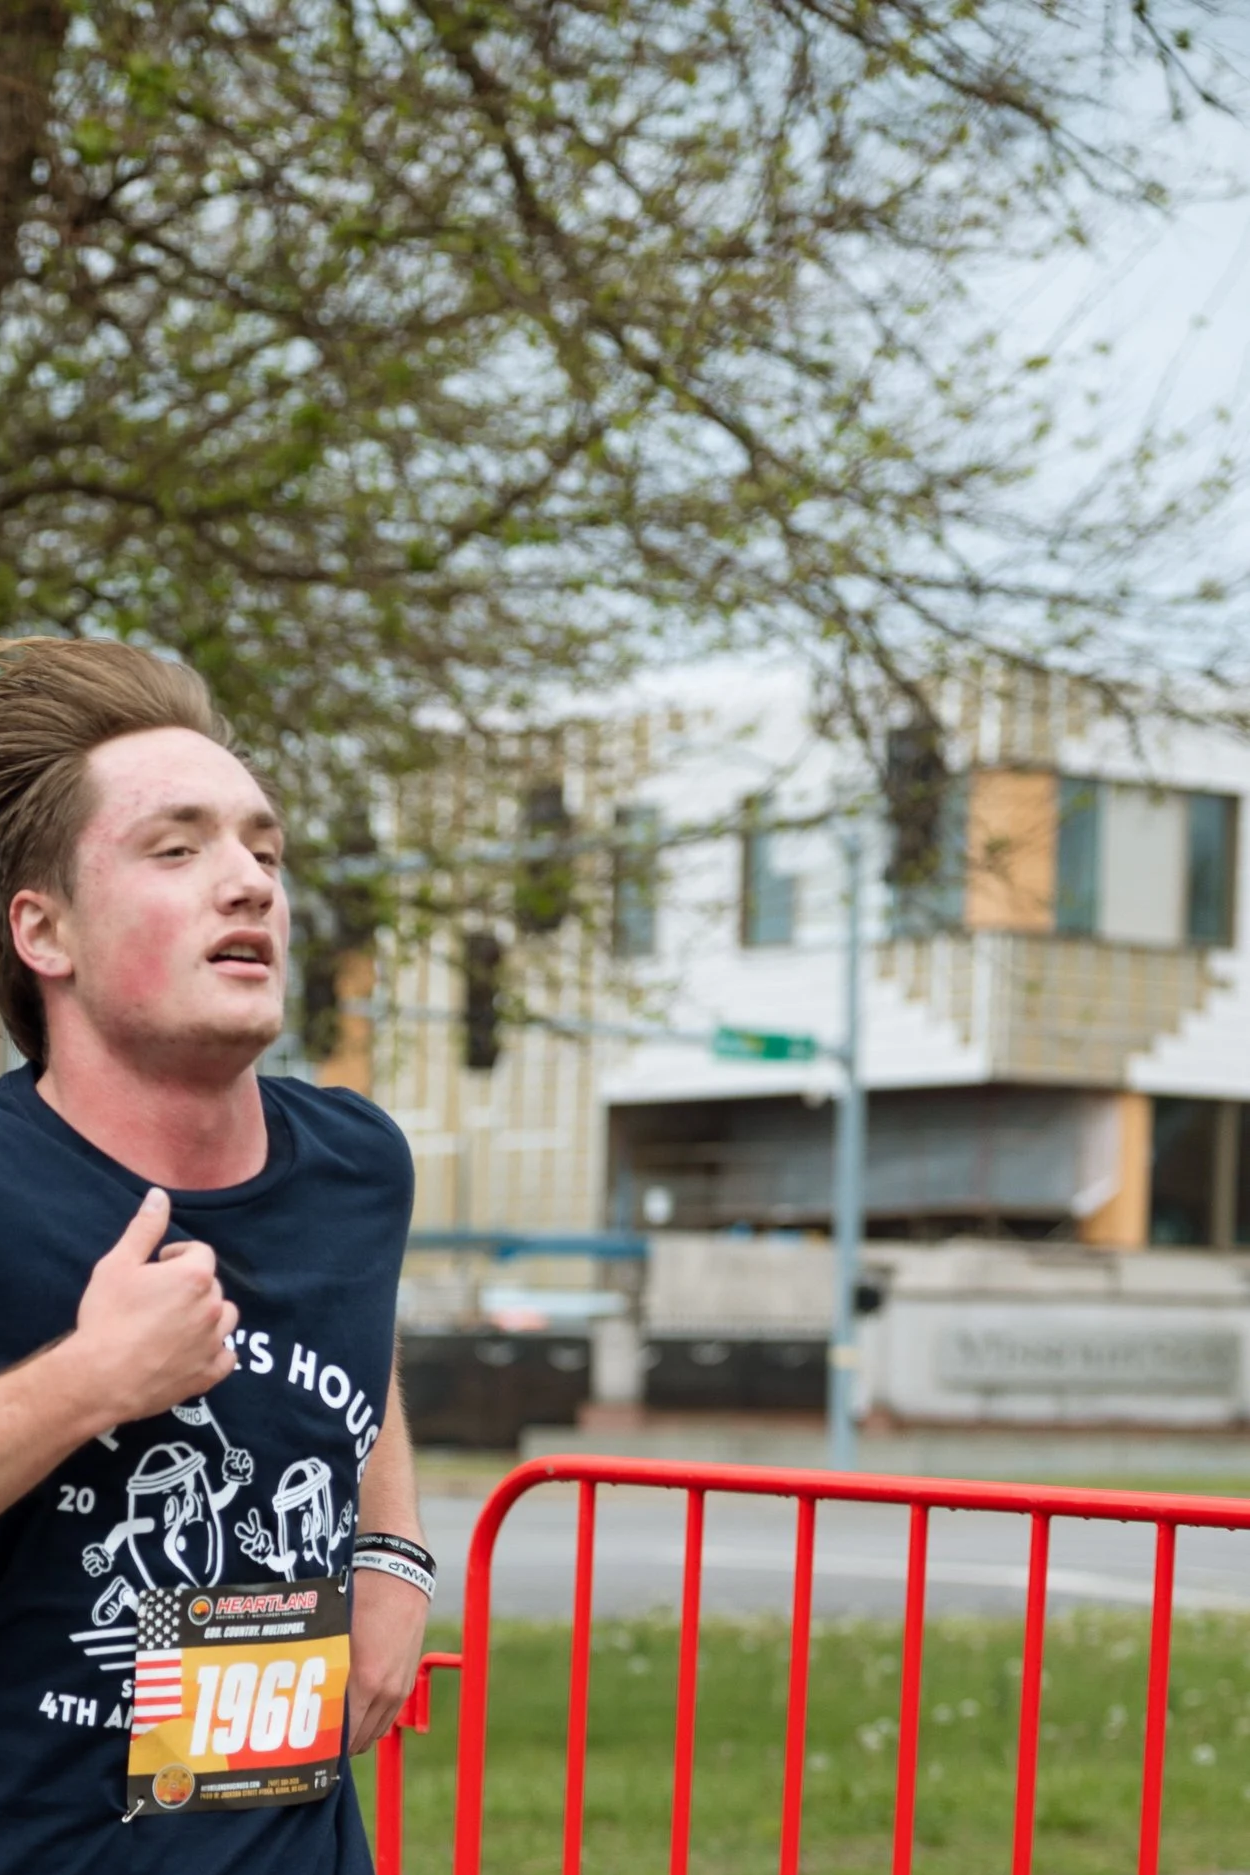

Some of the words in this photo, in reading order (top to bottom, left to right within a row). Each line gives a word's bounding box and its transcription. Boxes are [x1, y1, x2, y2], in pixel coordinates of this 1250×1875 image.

[224, 1329, 274, 1375] 'S
[56, 1484, 96, 1515] 20
[215, 1590, 318, 1615] HEARTLAND
[39, 1691, 97, 1727] 4TH
[189, 1656, 326, 1756] 1966
